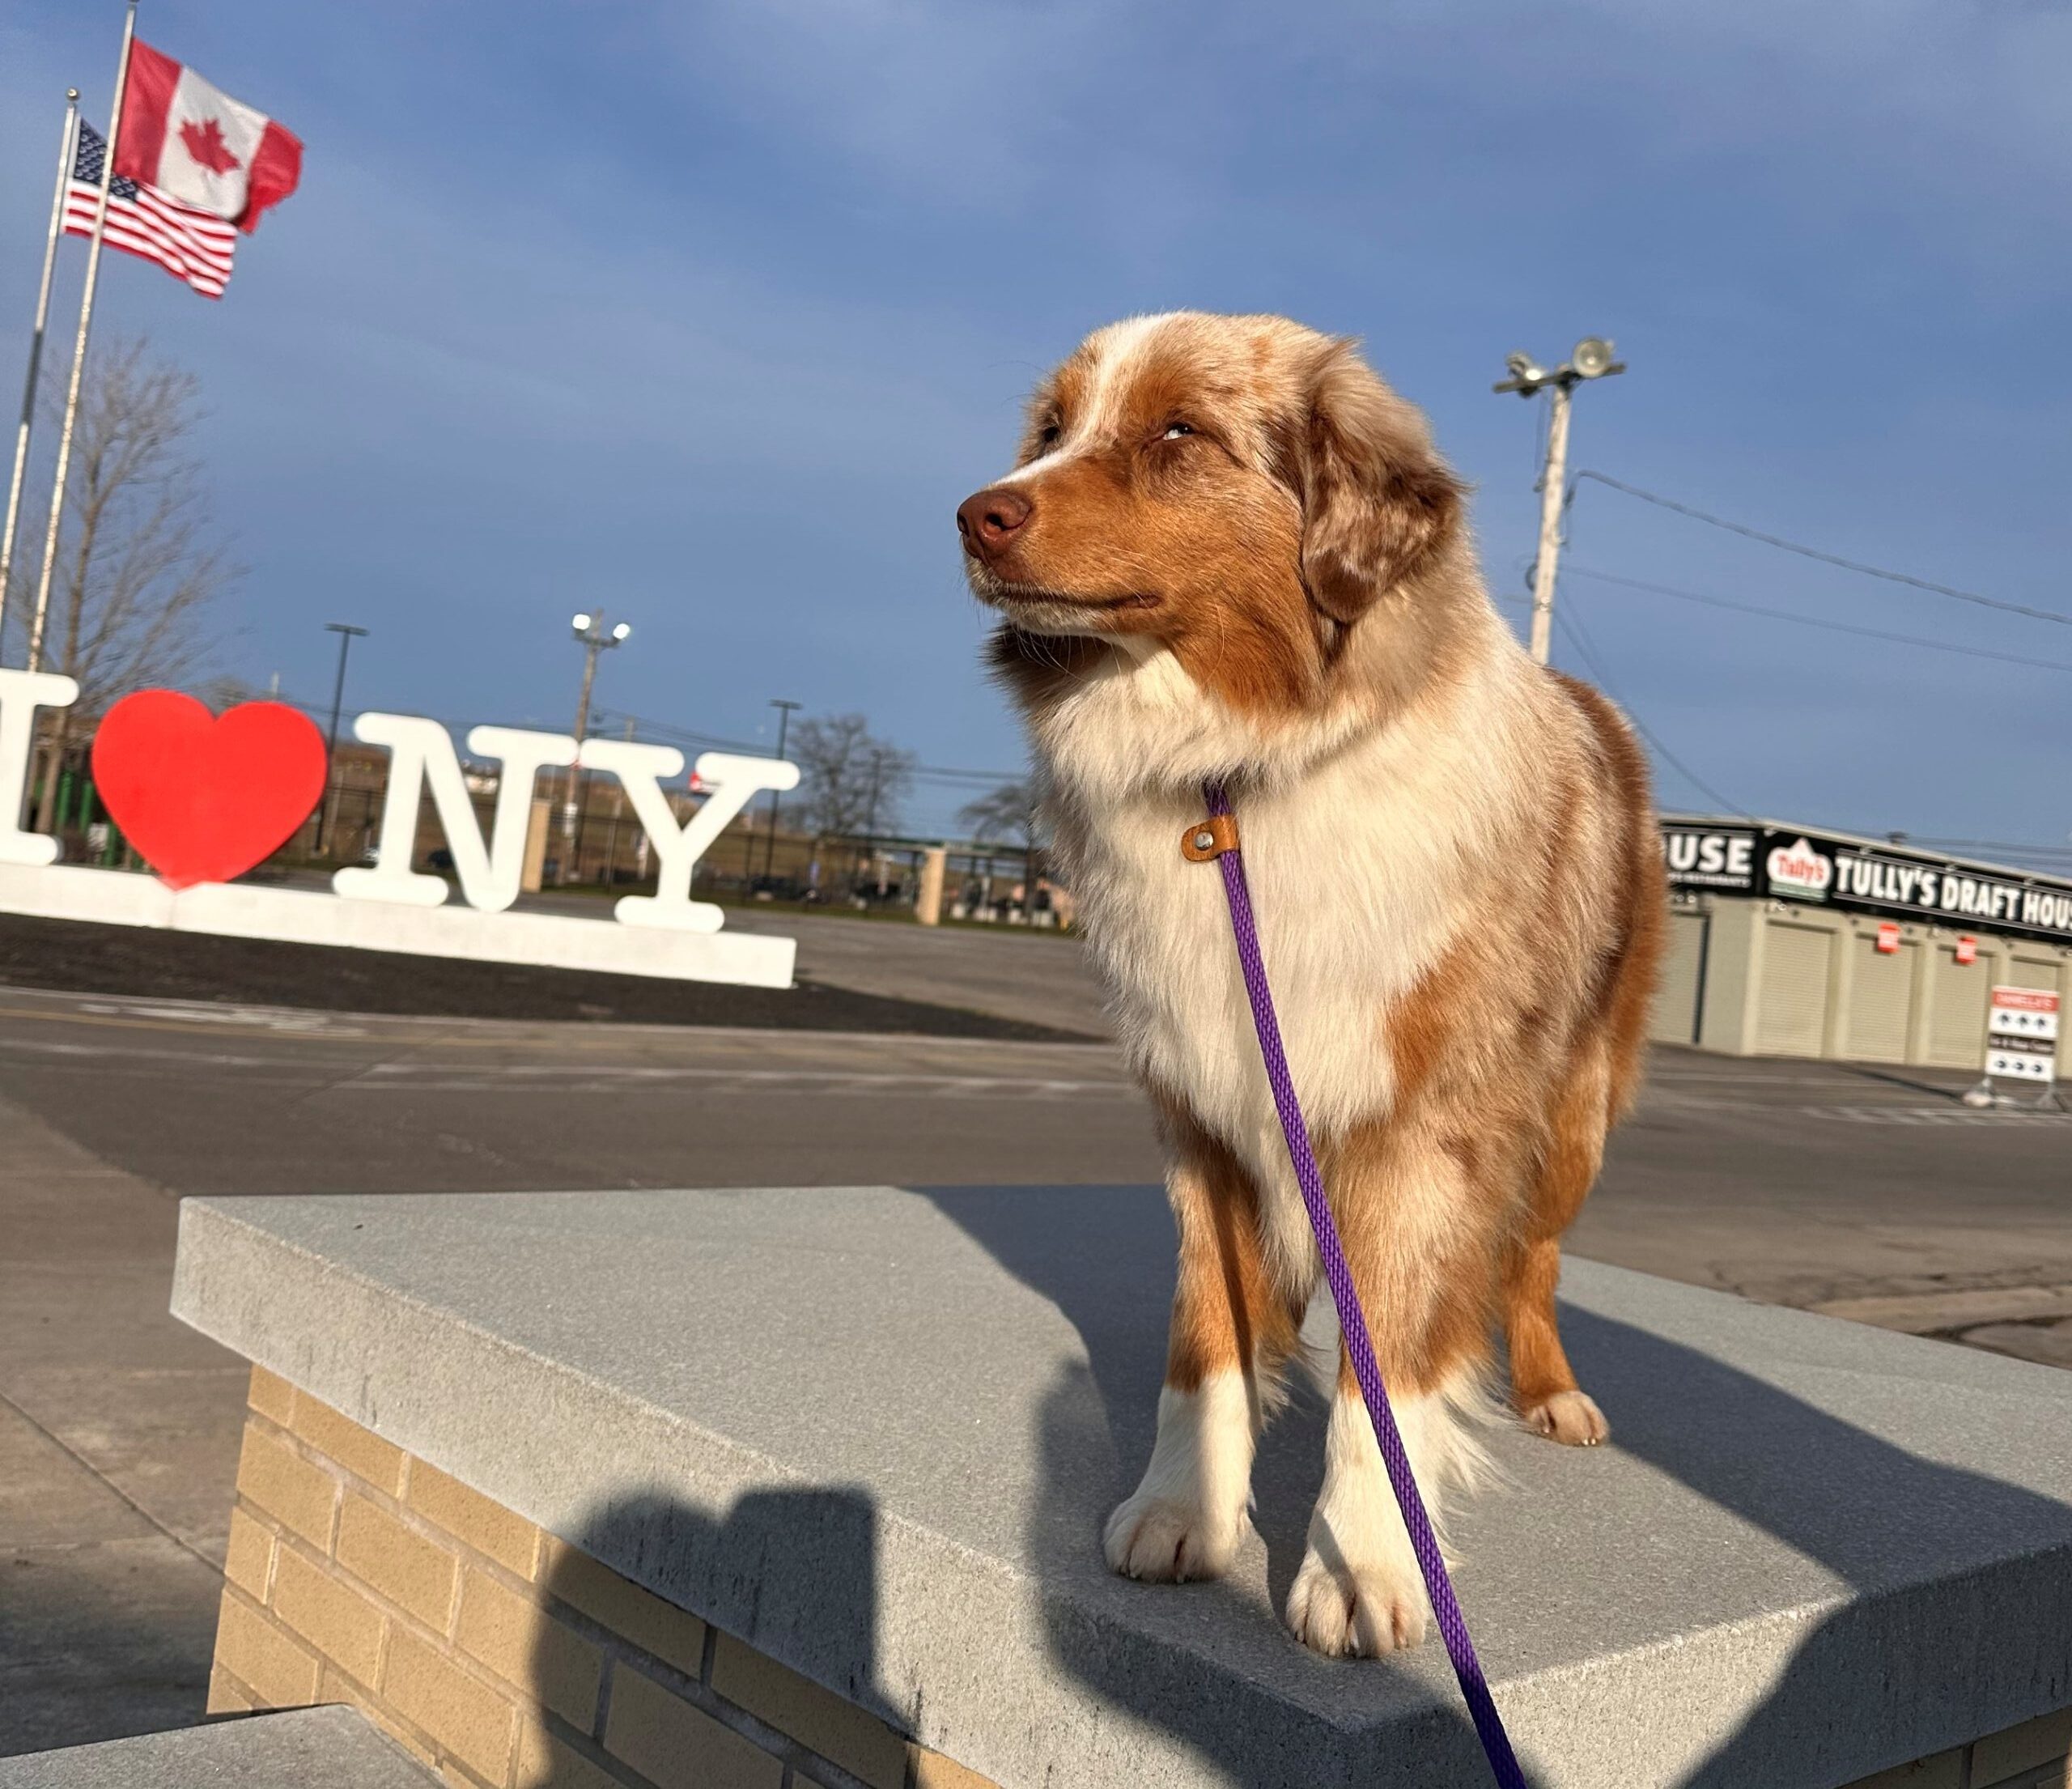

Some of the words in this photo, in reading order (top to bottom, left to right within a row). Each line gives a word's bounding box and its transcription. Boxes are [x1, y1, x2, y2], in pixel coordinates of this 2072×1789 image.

[333, 712, 800, 933] NY
[1663, 834, 1755, 874] USE
[1835, 856, 1937, 907] TULLY'S
[1941, 874, 2021, 920] DRAFT
[2023, 890, 2072, 930] HOU
